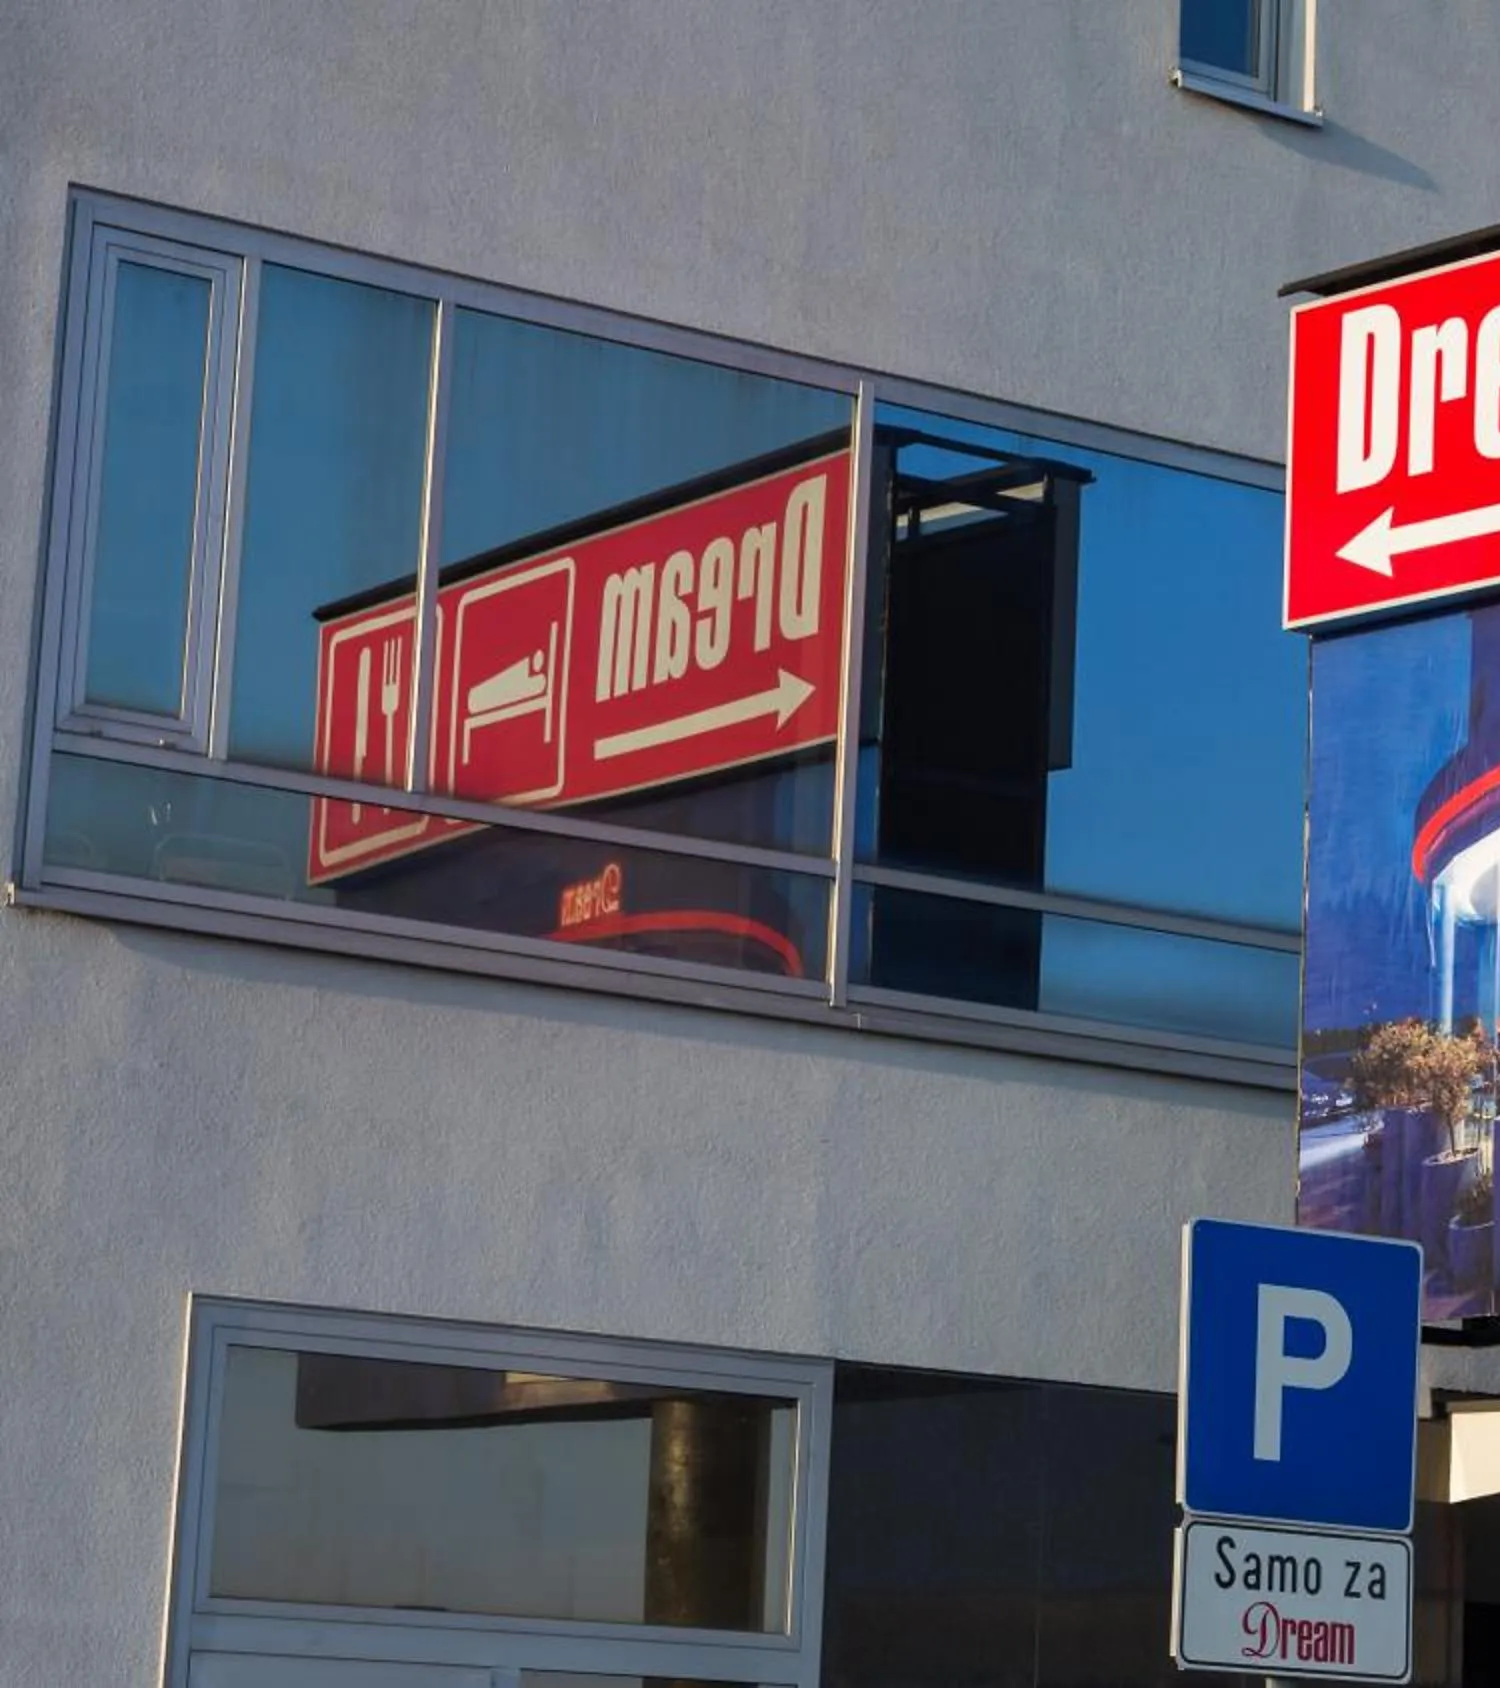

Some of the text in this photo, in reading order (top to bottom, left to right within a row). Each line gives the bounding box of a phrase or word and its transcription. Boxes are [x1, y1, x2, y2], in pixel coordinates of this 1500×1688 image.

[1253, 1283, 1353, 1462] P
[1214, 1535, 1386, 1600] Samo za
[1241, 1601, 1355, 1665] Dream
